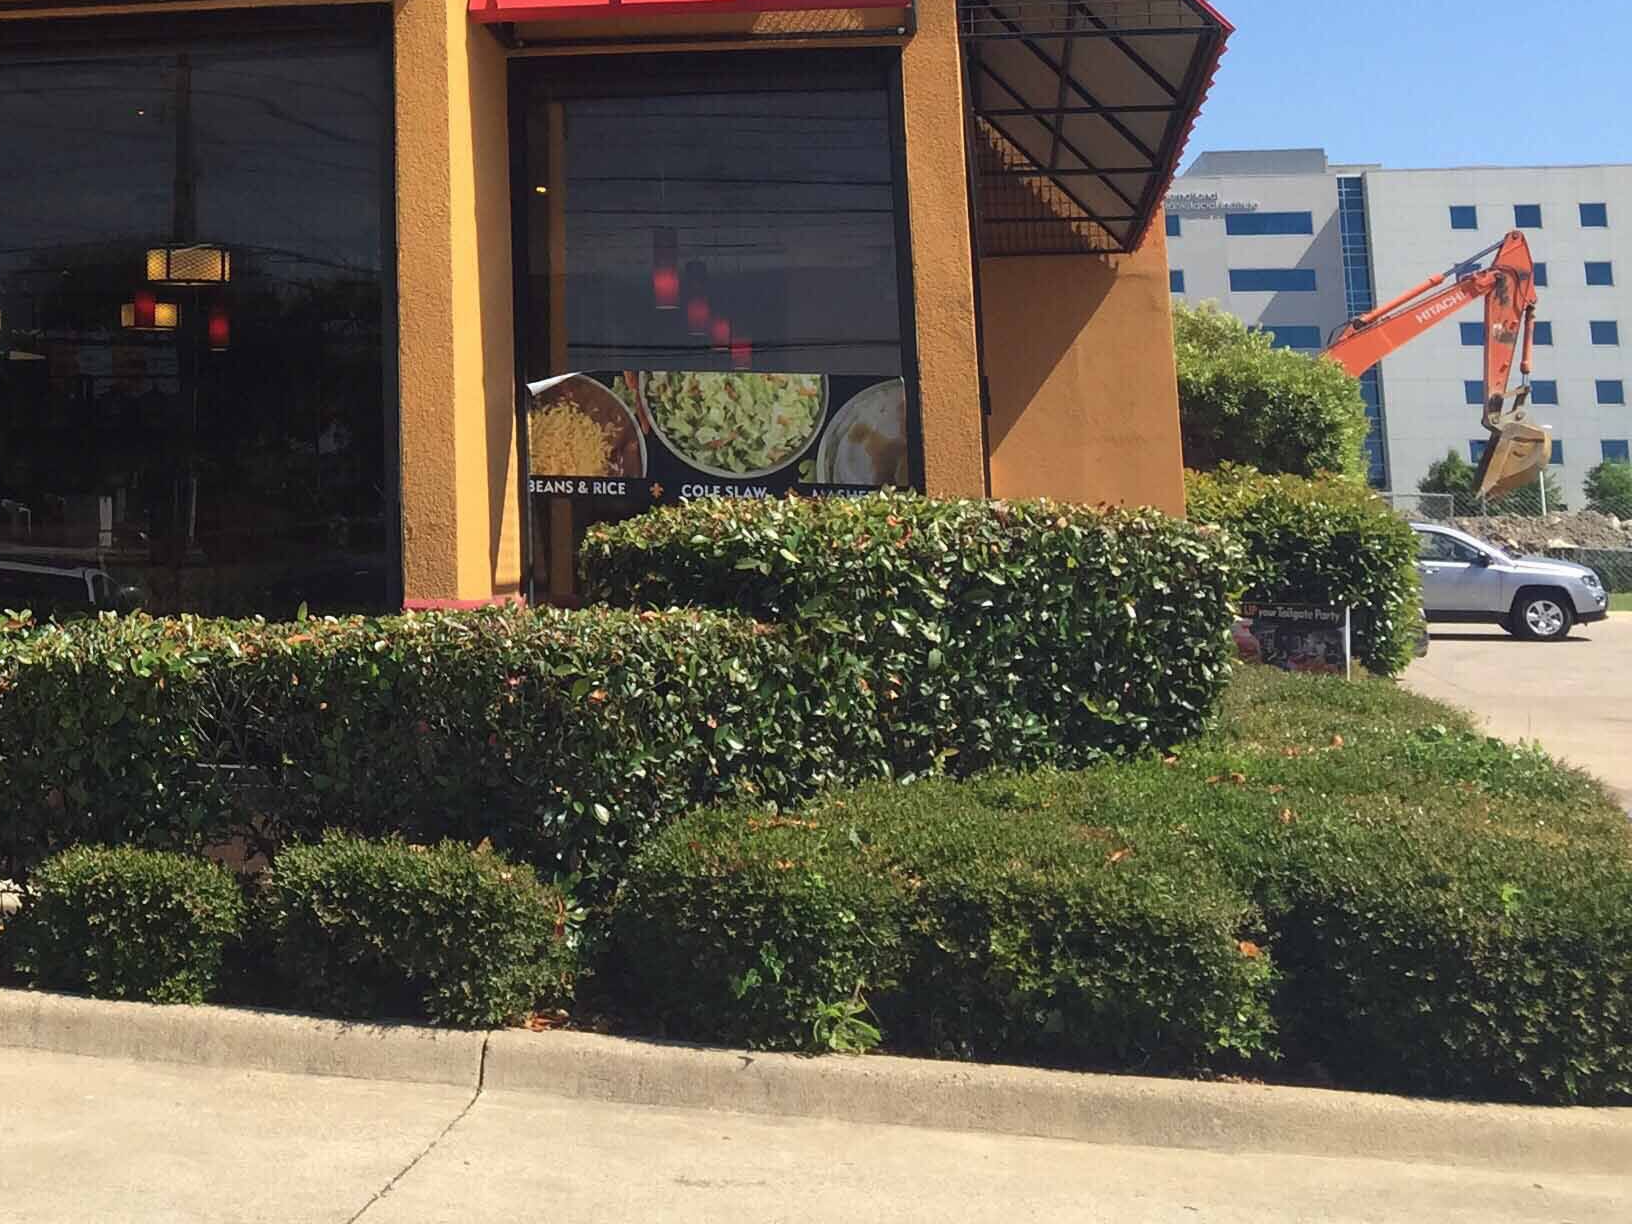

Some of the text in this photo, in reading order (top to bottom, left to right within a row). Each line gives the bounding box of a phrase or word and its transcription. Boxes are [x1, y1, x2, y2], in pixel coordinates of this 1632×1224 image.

[1414, 287, 1467, 324] HITACHI
[529, 480, 626, 495] BEANS & RICE
[681, 484, 768, 499] COLE SLAW
